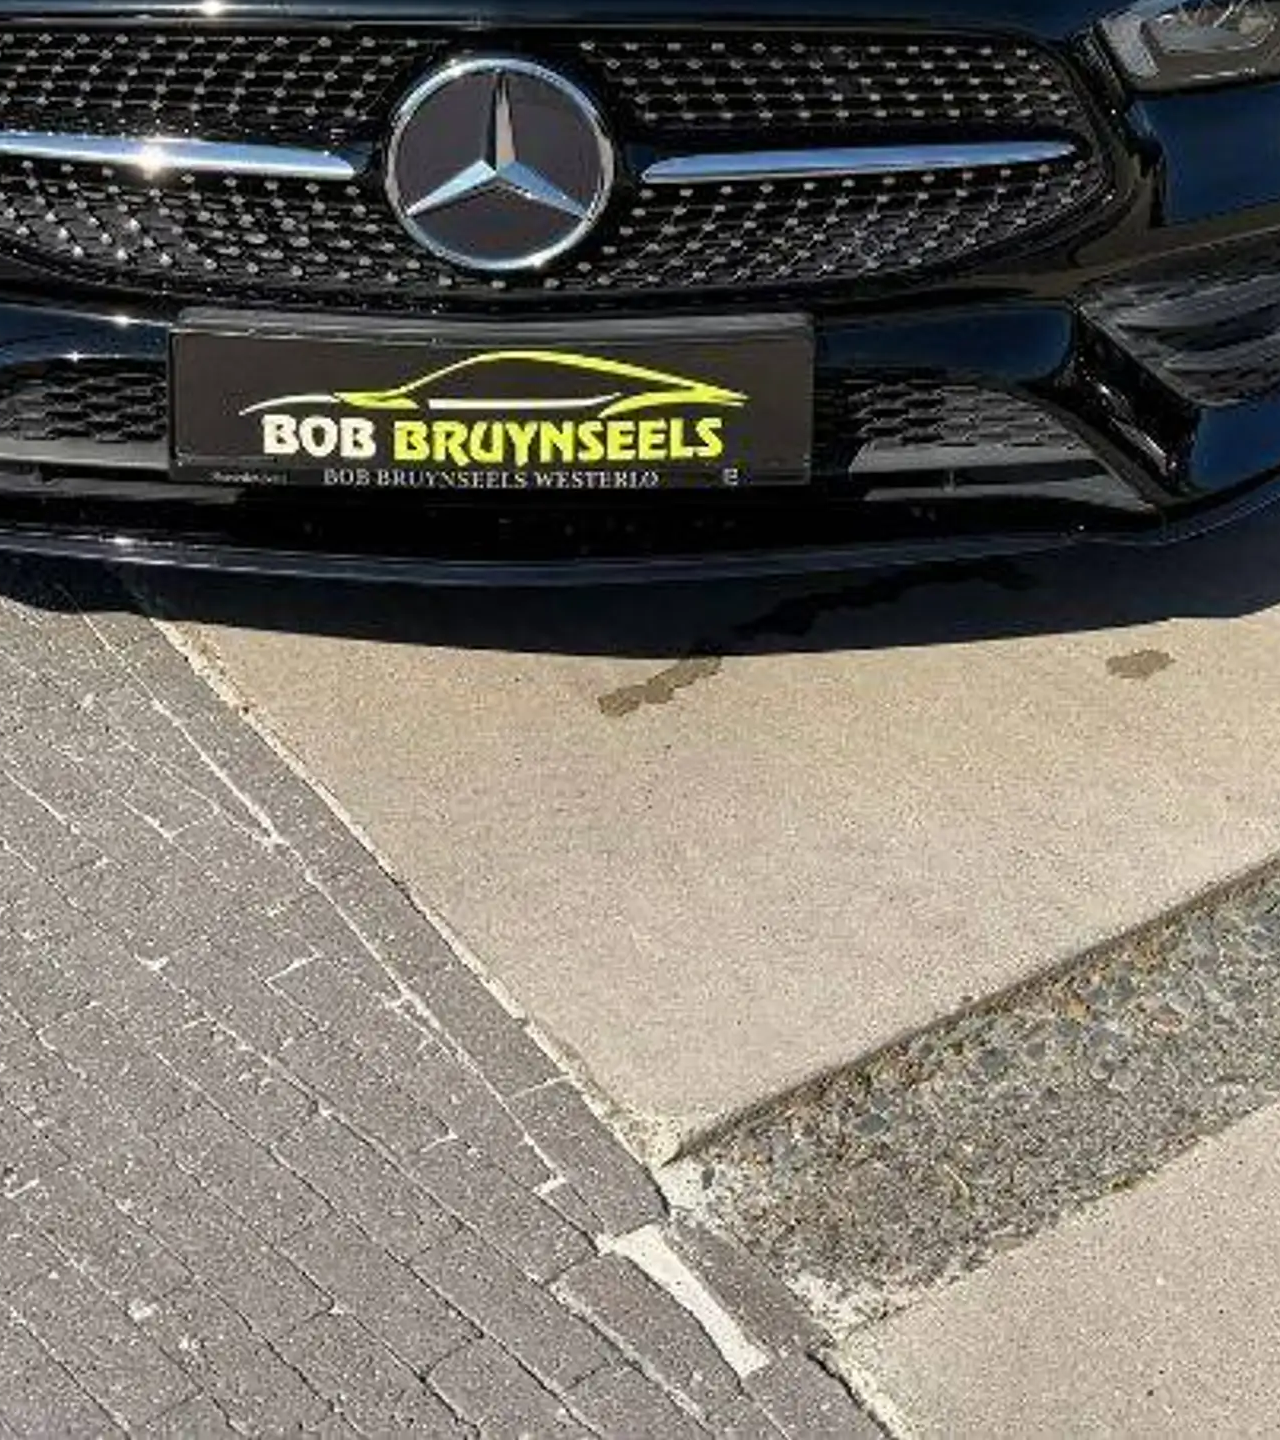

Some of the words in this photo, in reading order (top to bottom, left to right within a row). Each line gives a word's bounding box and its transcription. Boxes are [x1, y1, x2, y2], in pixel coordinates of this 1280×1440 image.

[262, 413, 377, 458] BOB
[393, 417, 724, 467] BRUYNSEELS
[323, 468, 371, 487] BOB
[376, 469, 528, 490] BRUYNSEELS
